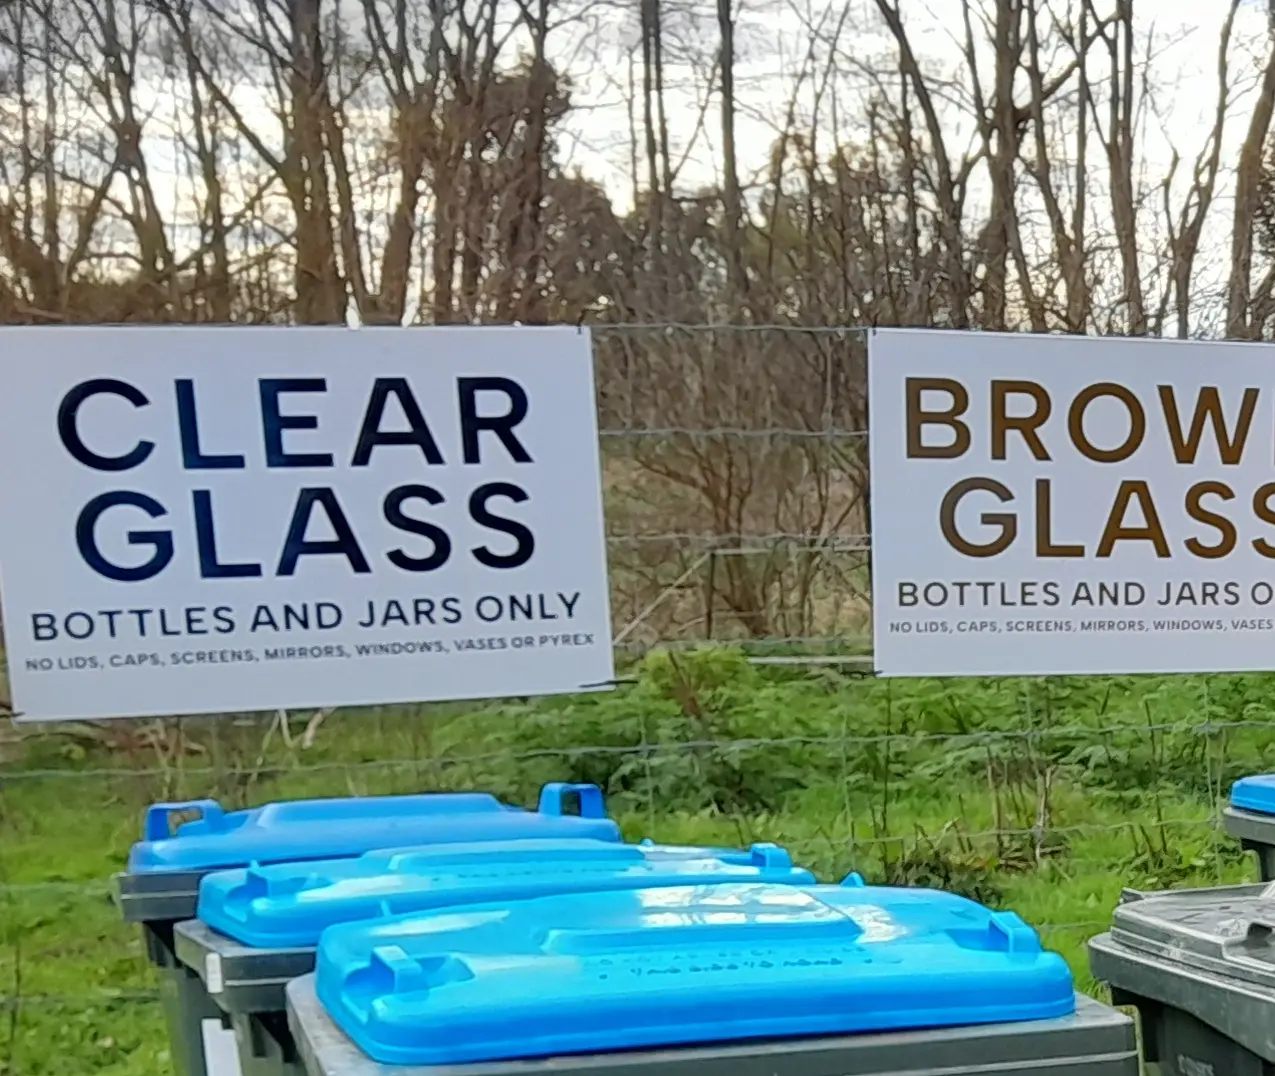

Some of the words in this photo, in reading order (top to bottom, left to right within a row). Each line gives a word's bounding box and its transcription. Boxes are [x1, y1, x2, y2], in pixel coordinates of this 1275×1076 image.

[57, 377, 533, 471] CLEAR
[76, 482, 535, 582] GLASS
[899, 582, 1060, 606] BOTTLES
[1072, 582, 1145, 606] AND
[1158, 582, 1239, 605] JARS
[32, 607, 235, 640] BOTTLES
[251, 603, 342, 632] AND
[359, 598, 461, 627] JARS
[476, 592, 580, 622] ONLY
[890, 622, 912, 633] NO
[916, 621, 953, 634] LIDS,
[957, 621, 1001, 633] CAPS,
[1006, 621, 1077, 633] SCREENS,
[1081, 620, 1149, 632] MIRRORS,
[1153, 620, 1227, 631] WINDOWS,
[1231, 619, 1273, 629] VASES
[26, 658, 53, 670] NO
[58, 656, 104, 670] LIDS,
[109, 653, 165, 667] CAPS,
[171, 650, 259, 665] SCREENS,
[265, 645, 351, 659] MIRRORS,
[355, 641, 449, 655] WINDOWS,
[454, 638, 507, 651] VASES
[511, 636, 534, 648] OR
[539, 634, 593, 646] PYREX
